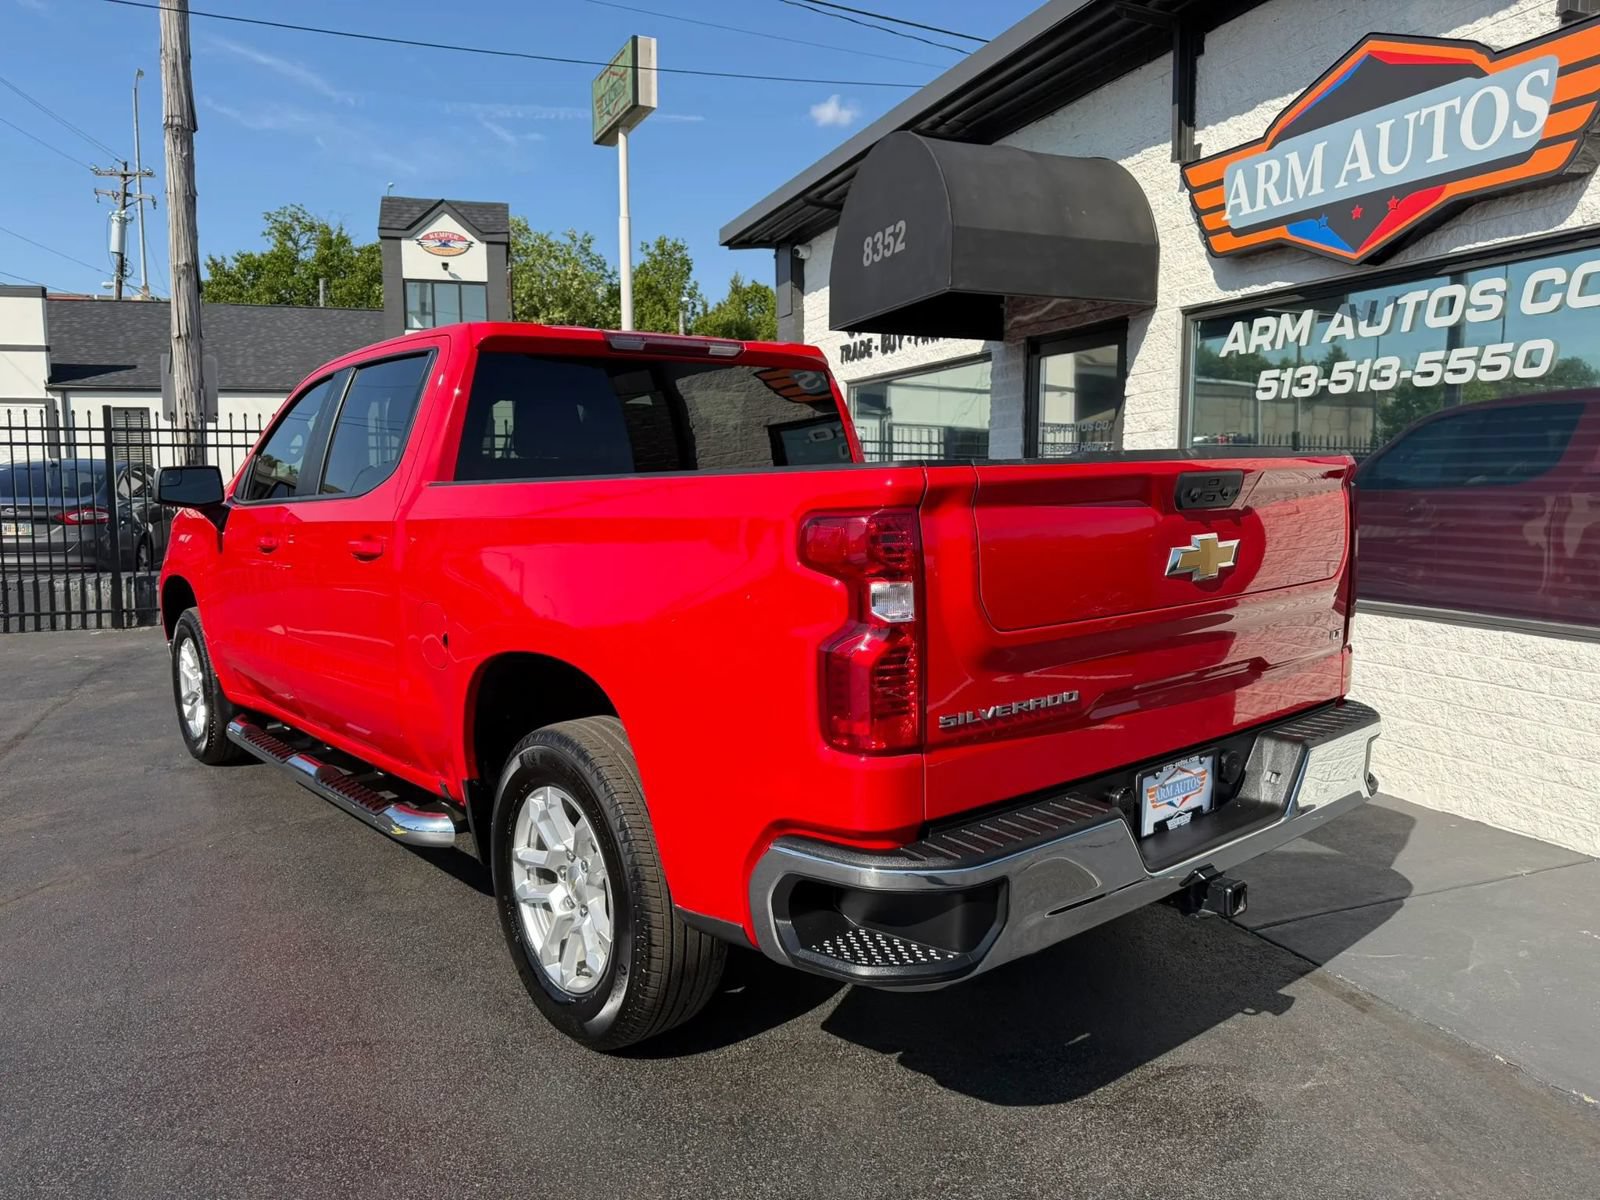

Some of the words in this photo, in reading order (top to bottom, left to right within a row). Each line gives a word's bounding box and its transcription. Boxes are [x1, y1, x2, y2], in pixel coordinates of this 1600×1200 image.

[1221, 139, 1328, 222] ARM
[1334, 68, 1550, 190] AUTOS
[428, 231, 460, 240] KEMPER
[862, 219, 906, 267] 8352
[1219, 309, 1317, 358] ARM
[1321, 278, 1508, 343] AUTOS
[839, 338, 874, 365] TRADE
[1255, 338, 1556, 401] 513-513-5550
[938, 689, 1080, 729] SILVERADO
[1155, 784, 1174, 801] ARM
[1174, 776, 1201, 796] AUTOS
